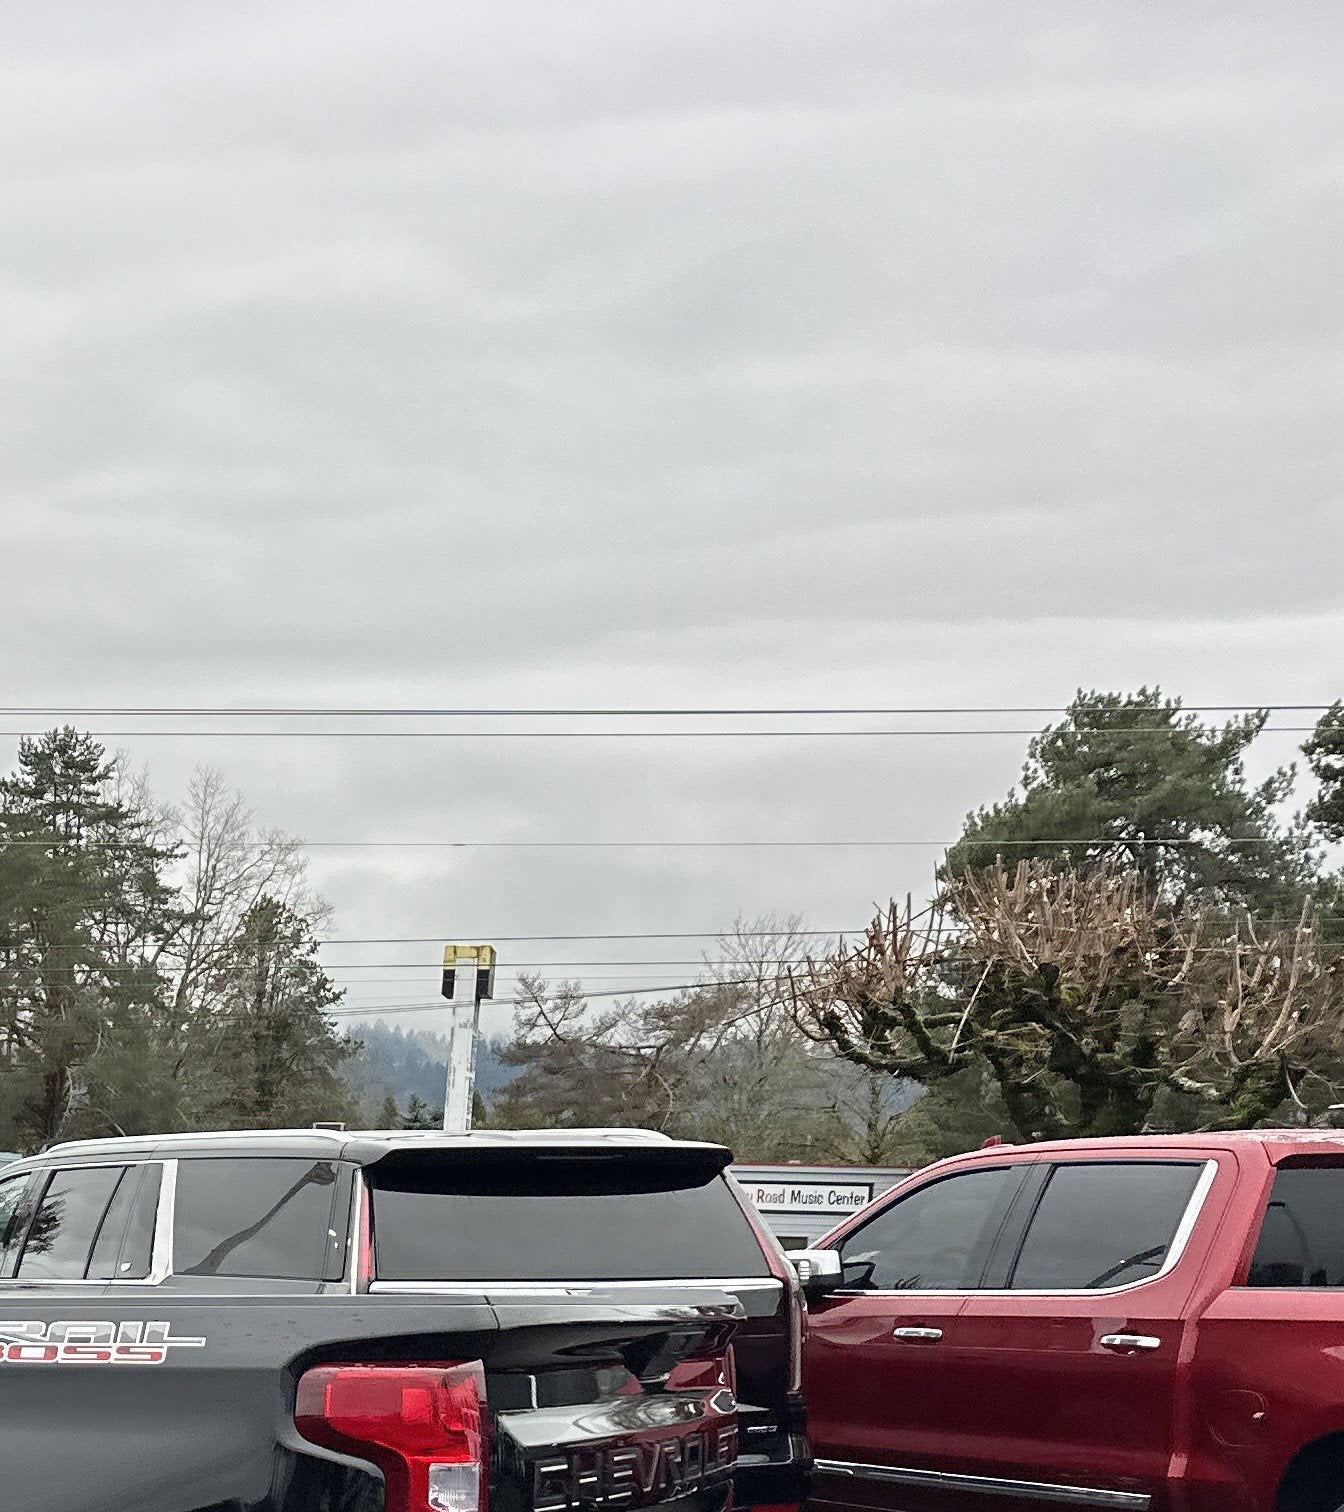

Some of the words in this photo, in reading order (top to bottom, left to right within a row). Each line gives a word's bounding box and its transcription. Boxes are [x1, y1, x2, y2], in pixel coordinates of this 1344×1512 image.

[756, 1188, 786, 1204] Road
[790, 1189, 824, 1205] Music
[828, 1190, 866, 1206] Center
